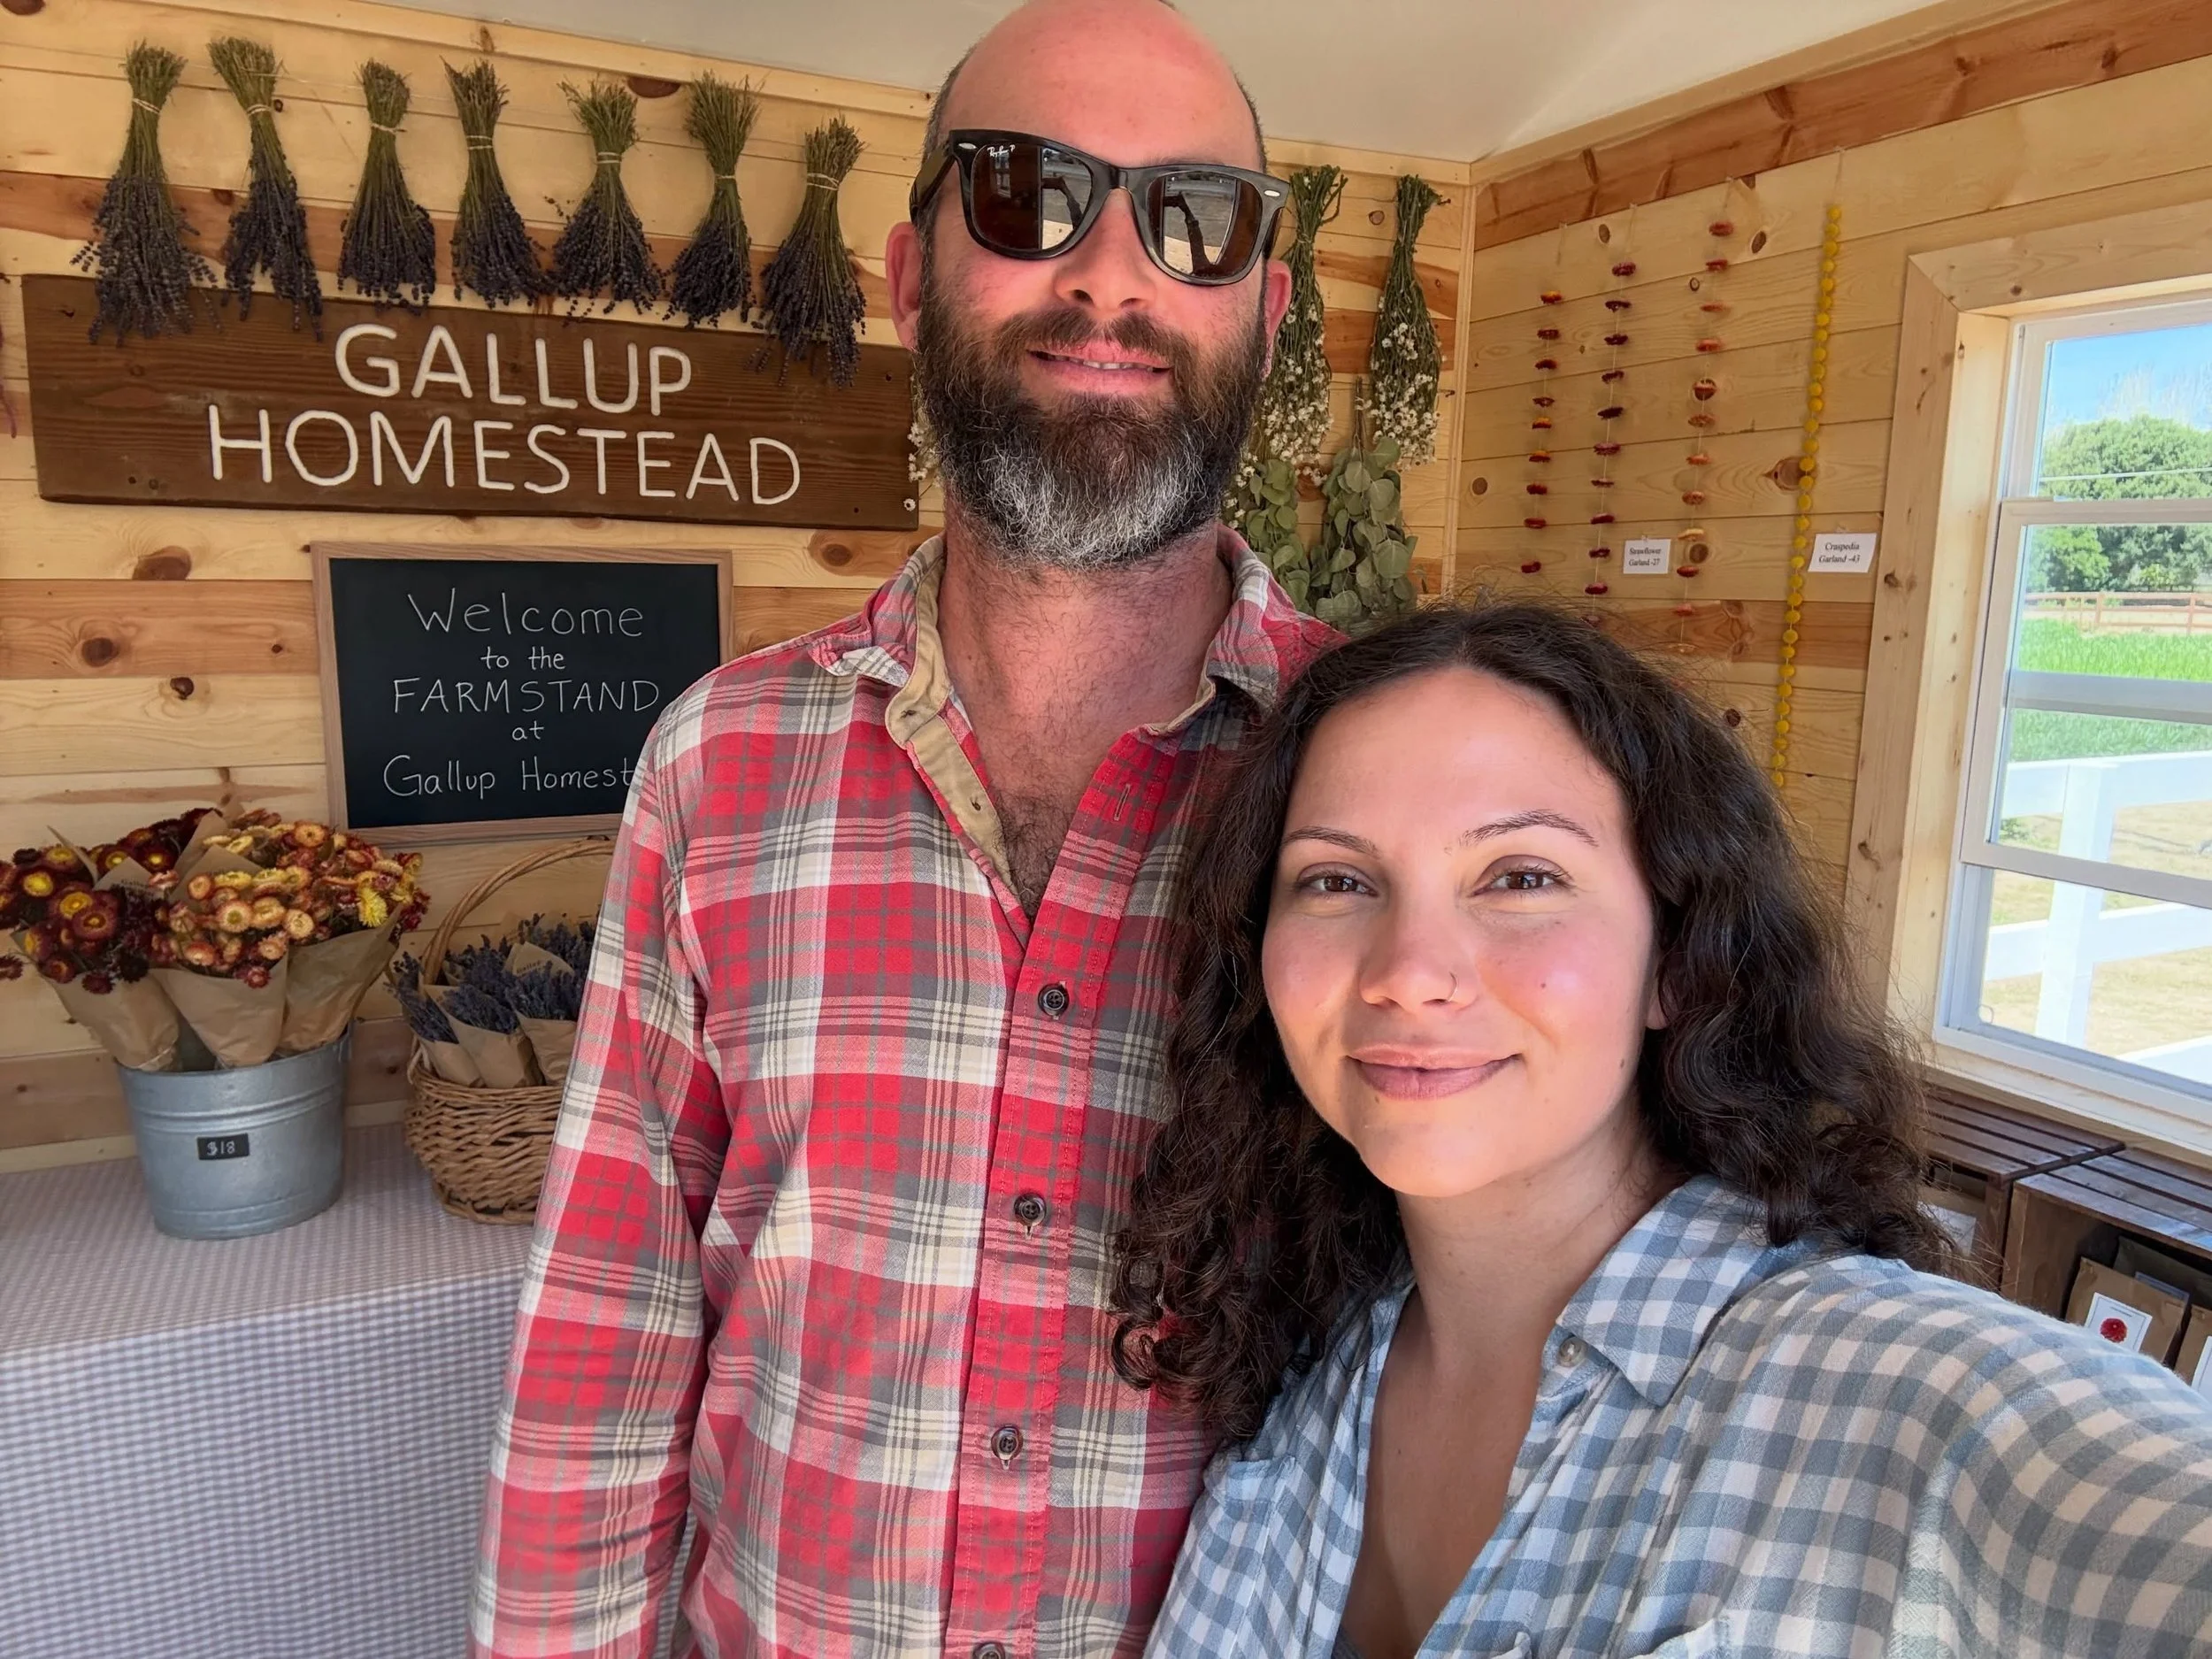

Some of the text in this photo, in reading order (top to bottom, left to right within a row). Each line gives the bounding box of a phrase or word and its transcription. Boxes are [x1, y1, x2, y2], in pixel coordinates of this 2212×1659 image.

[335, 323, 692, 417] GALLUP
[208, 404, 801, 505] HOMESTEAD
[407, 588, 643, 637] Welcome
[480, 646, 566, 670] to the
[393, 677, 659, 714] FARMSTAND
[511, 721, 545, 741] at
[383, 755, 633, 800] Gallup Homest
[206, 1141, 235, 1156] $18
